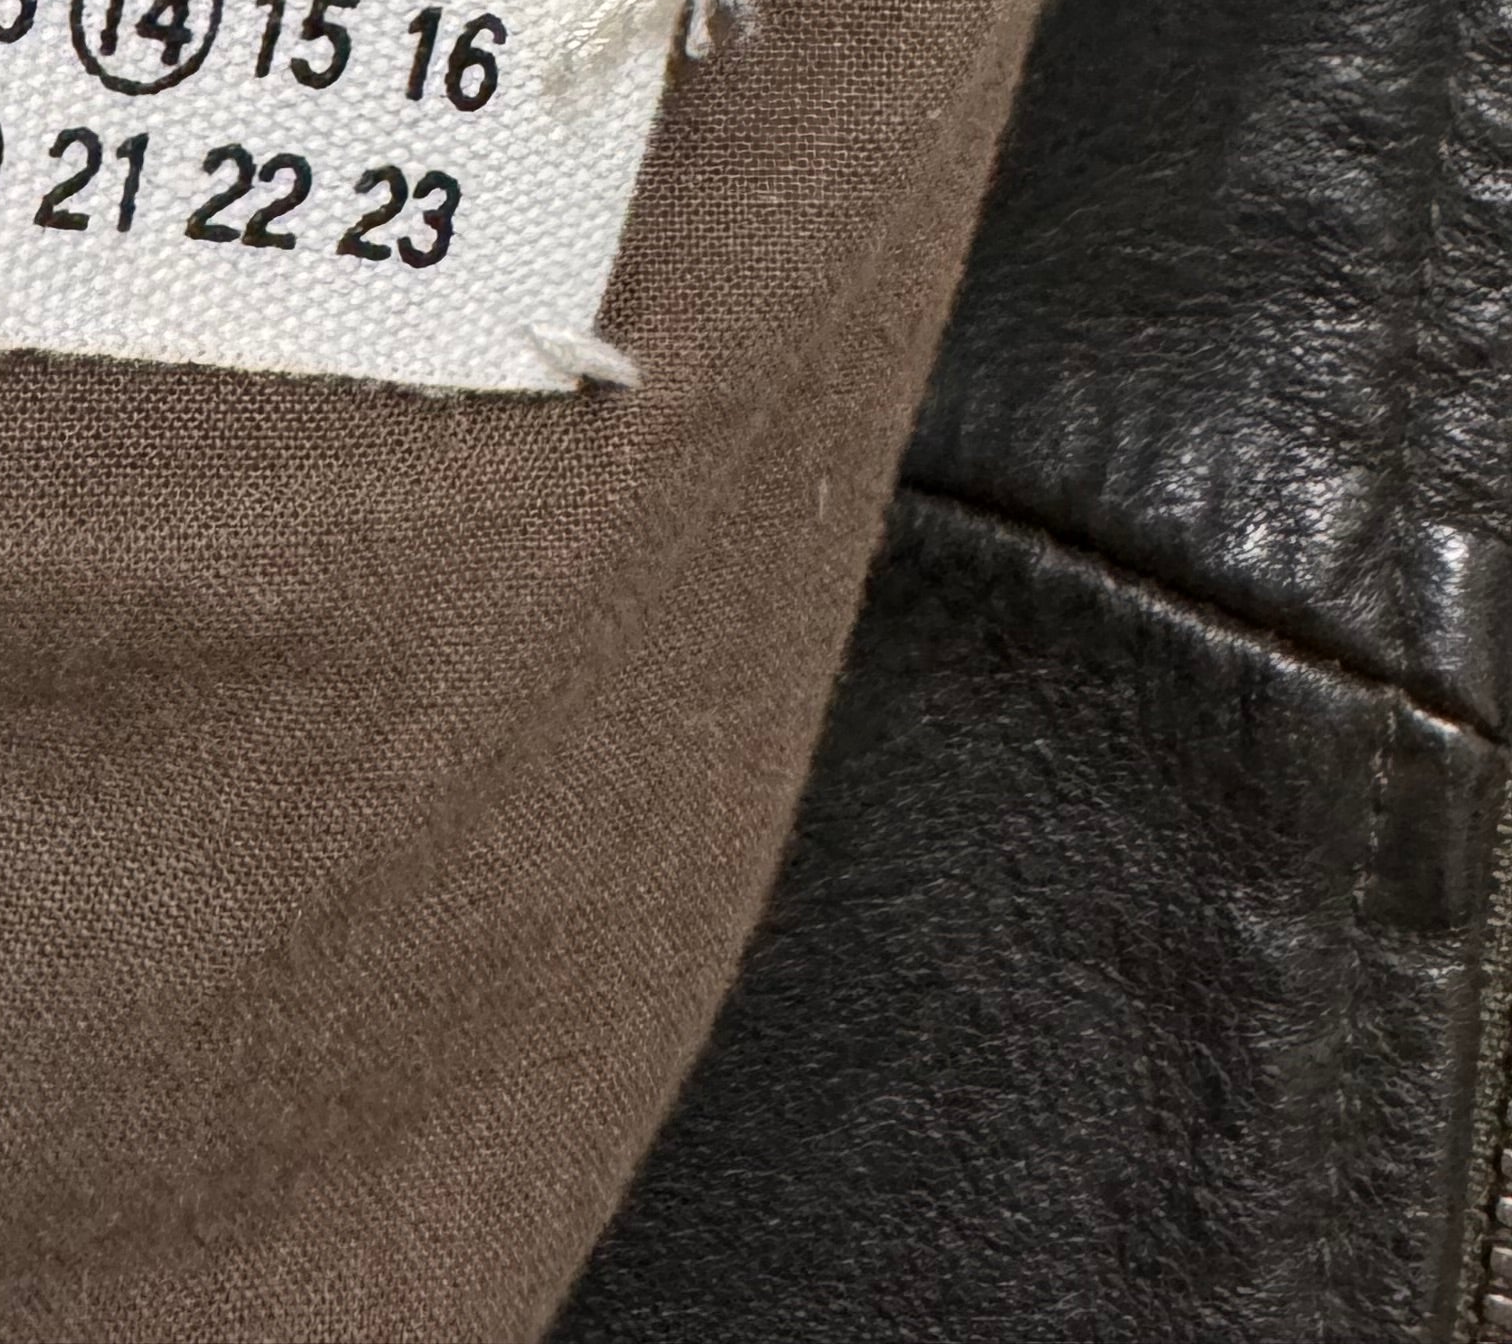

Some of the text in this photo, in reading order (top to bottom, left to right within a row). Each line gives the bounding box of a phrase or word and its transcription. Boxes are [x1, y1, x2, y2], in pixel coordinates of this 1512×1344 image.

[406, 7, 507, 112] 16
[34, 127, 148, 232] 21
[185, 144, 312, 250] 22
[337, 165, 462, 268] 23
